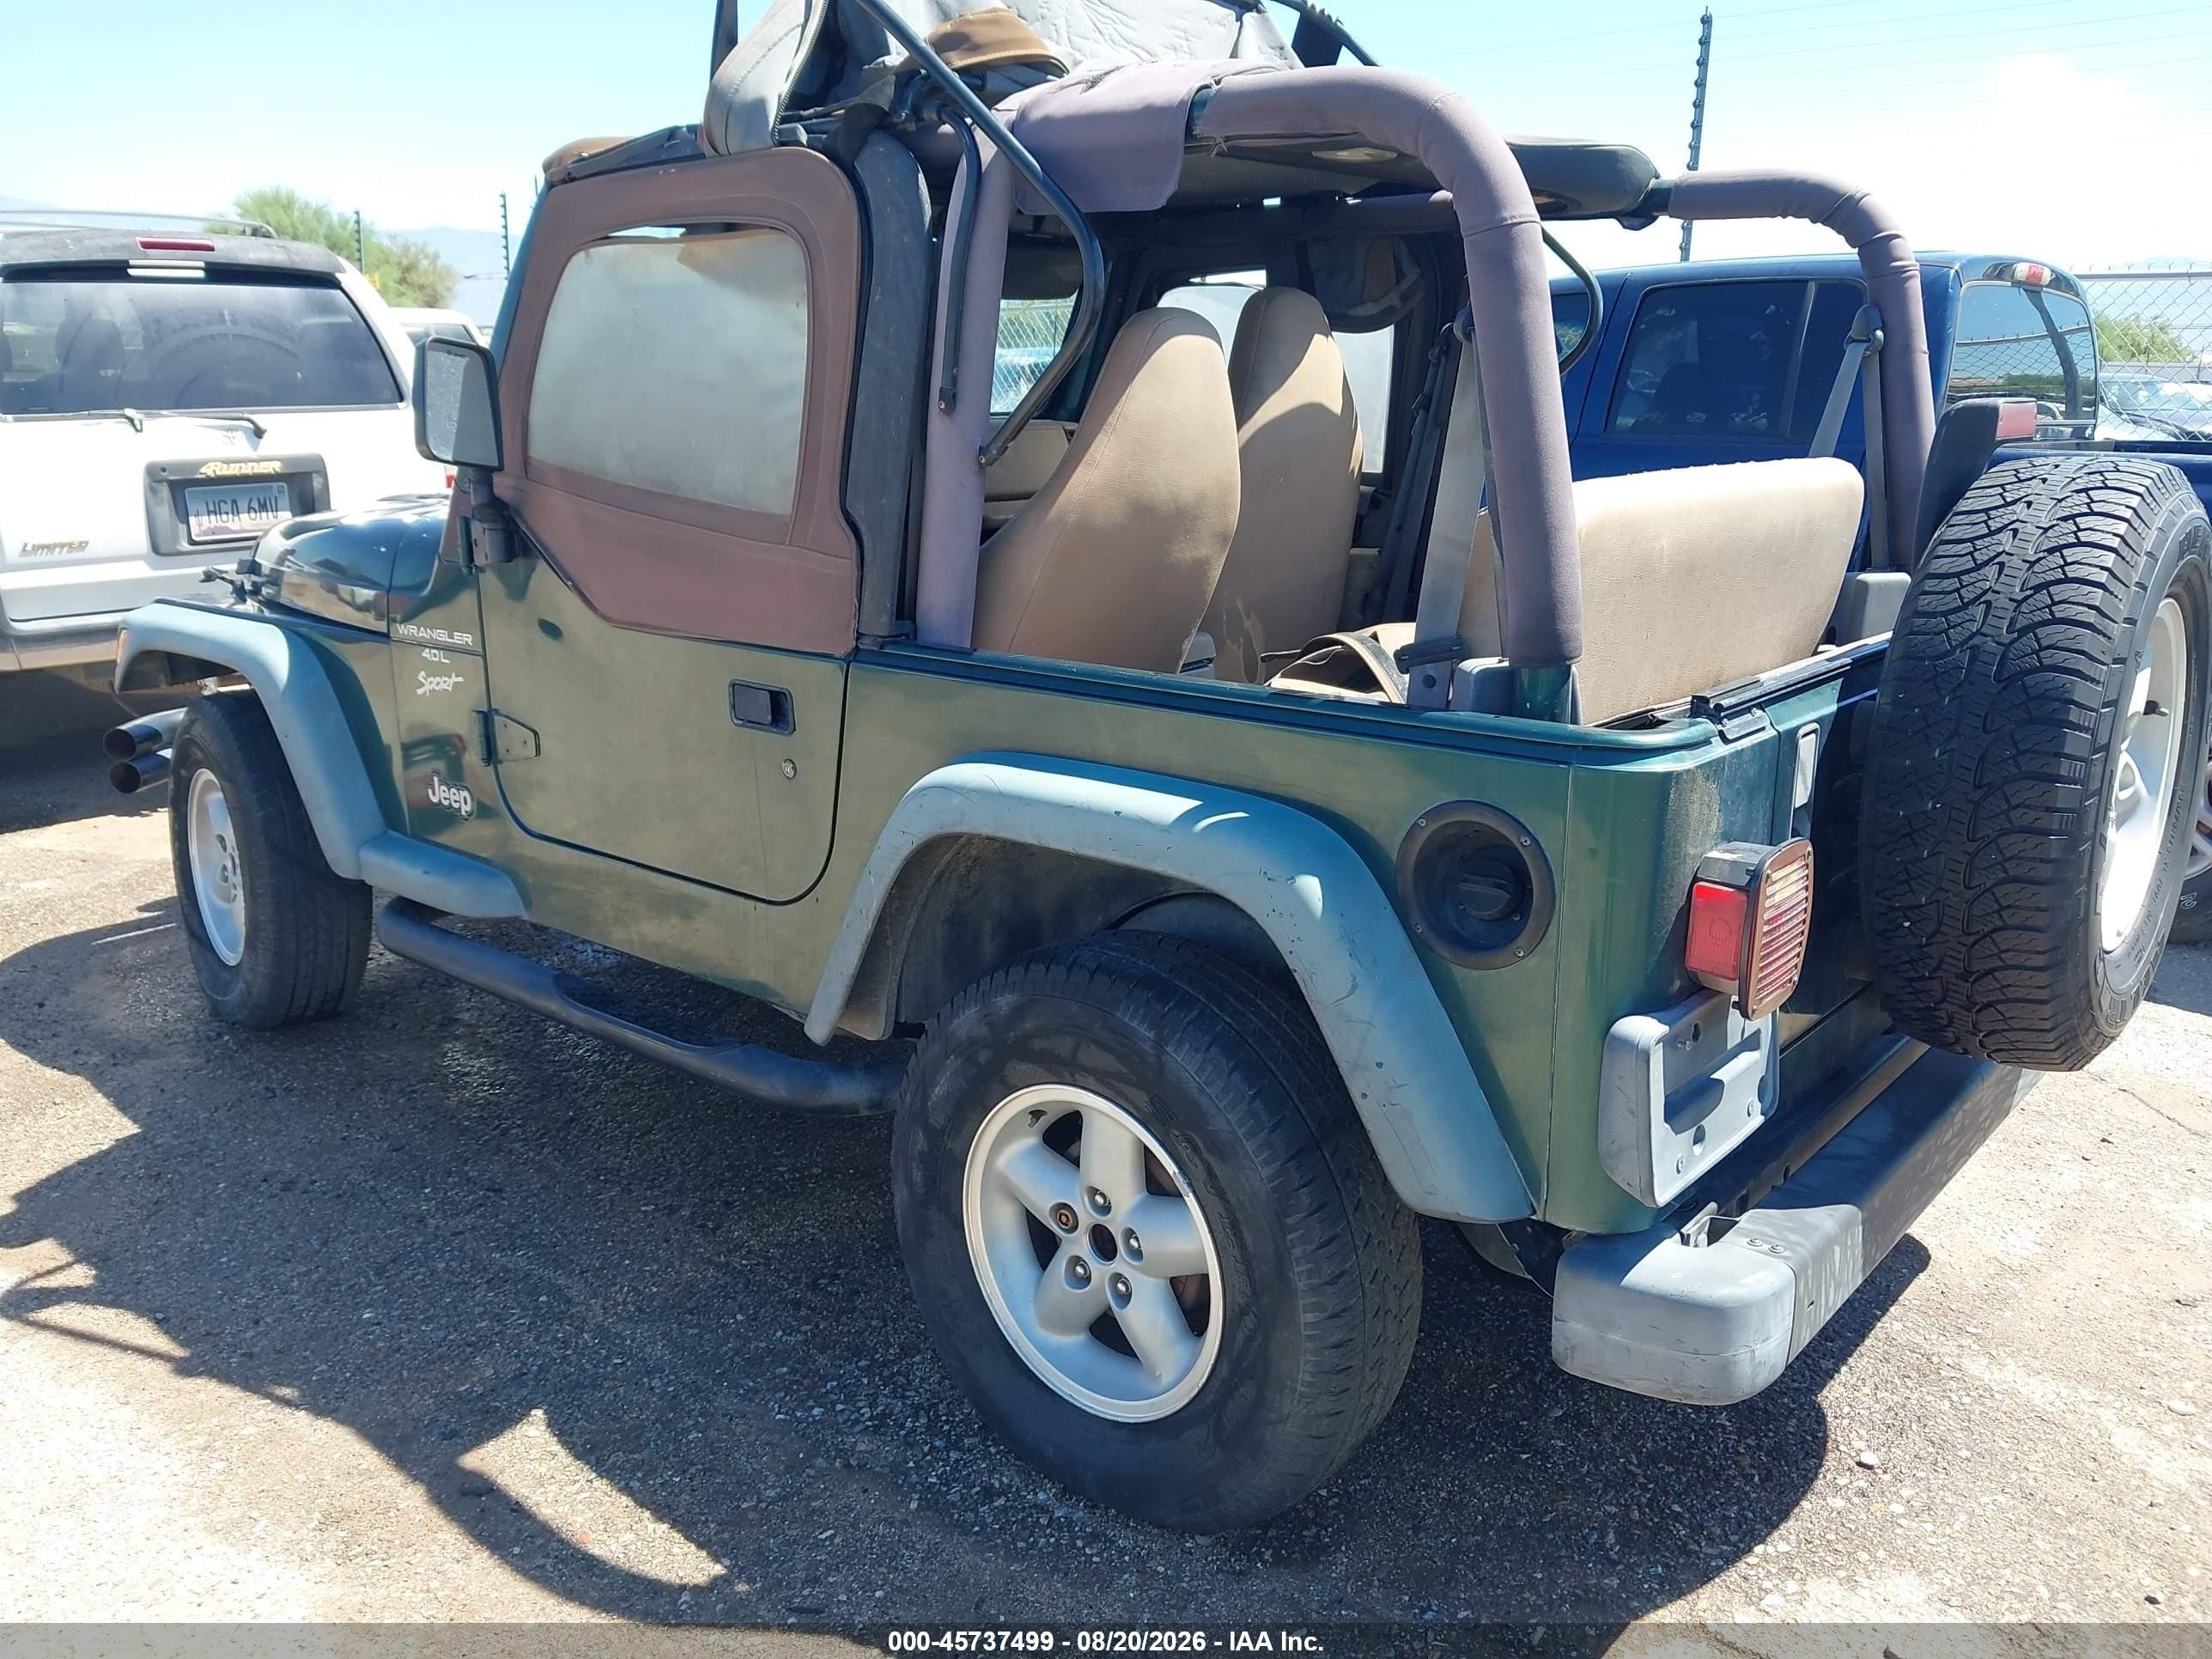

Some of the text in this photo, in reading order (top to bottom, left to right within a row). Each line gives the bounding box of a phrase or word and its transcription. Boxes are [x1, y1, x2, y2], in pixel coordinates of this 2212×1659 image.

[206, 495, 279, 524] HGA 6MV
[396, 623, 473, 646] WRANGLER
[428, 775, 471, 817] Jeep
